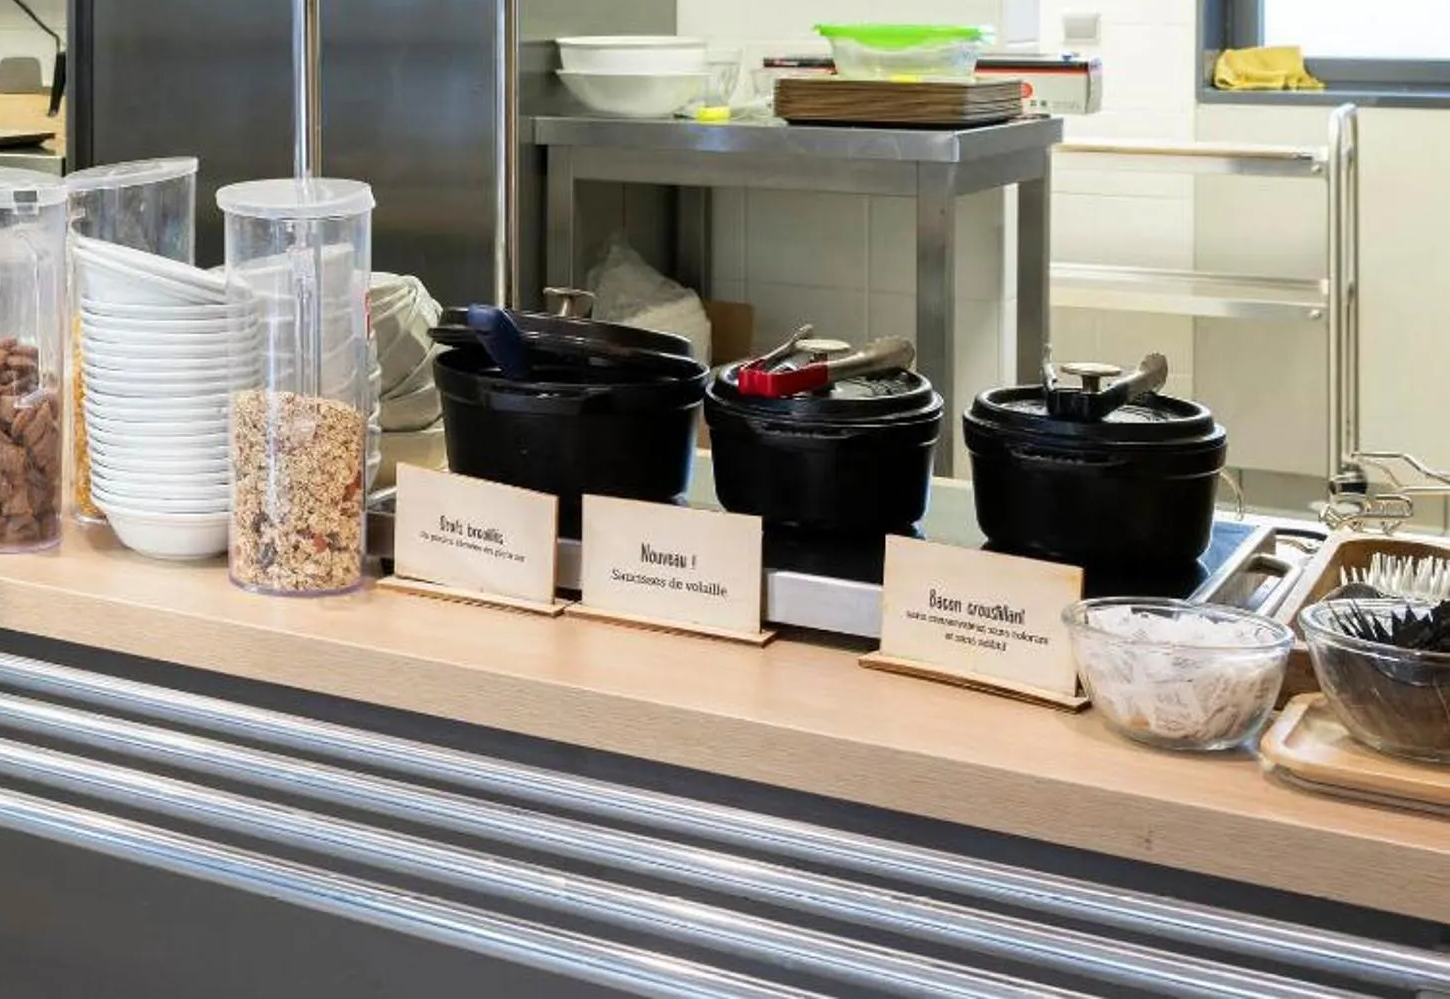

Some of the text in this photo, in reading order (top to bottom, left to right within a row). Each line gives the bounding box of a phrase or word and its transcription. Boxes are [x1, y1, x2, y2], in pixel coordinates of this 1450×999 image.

[640, 541, 687, 569] Nouveau
[610, 567, 729, 598] Saucisses de volaille
[928, 588, 963, 614] Bacon
